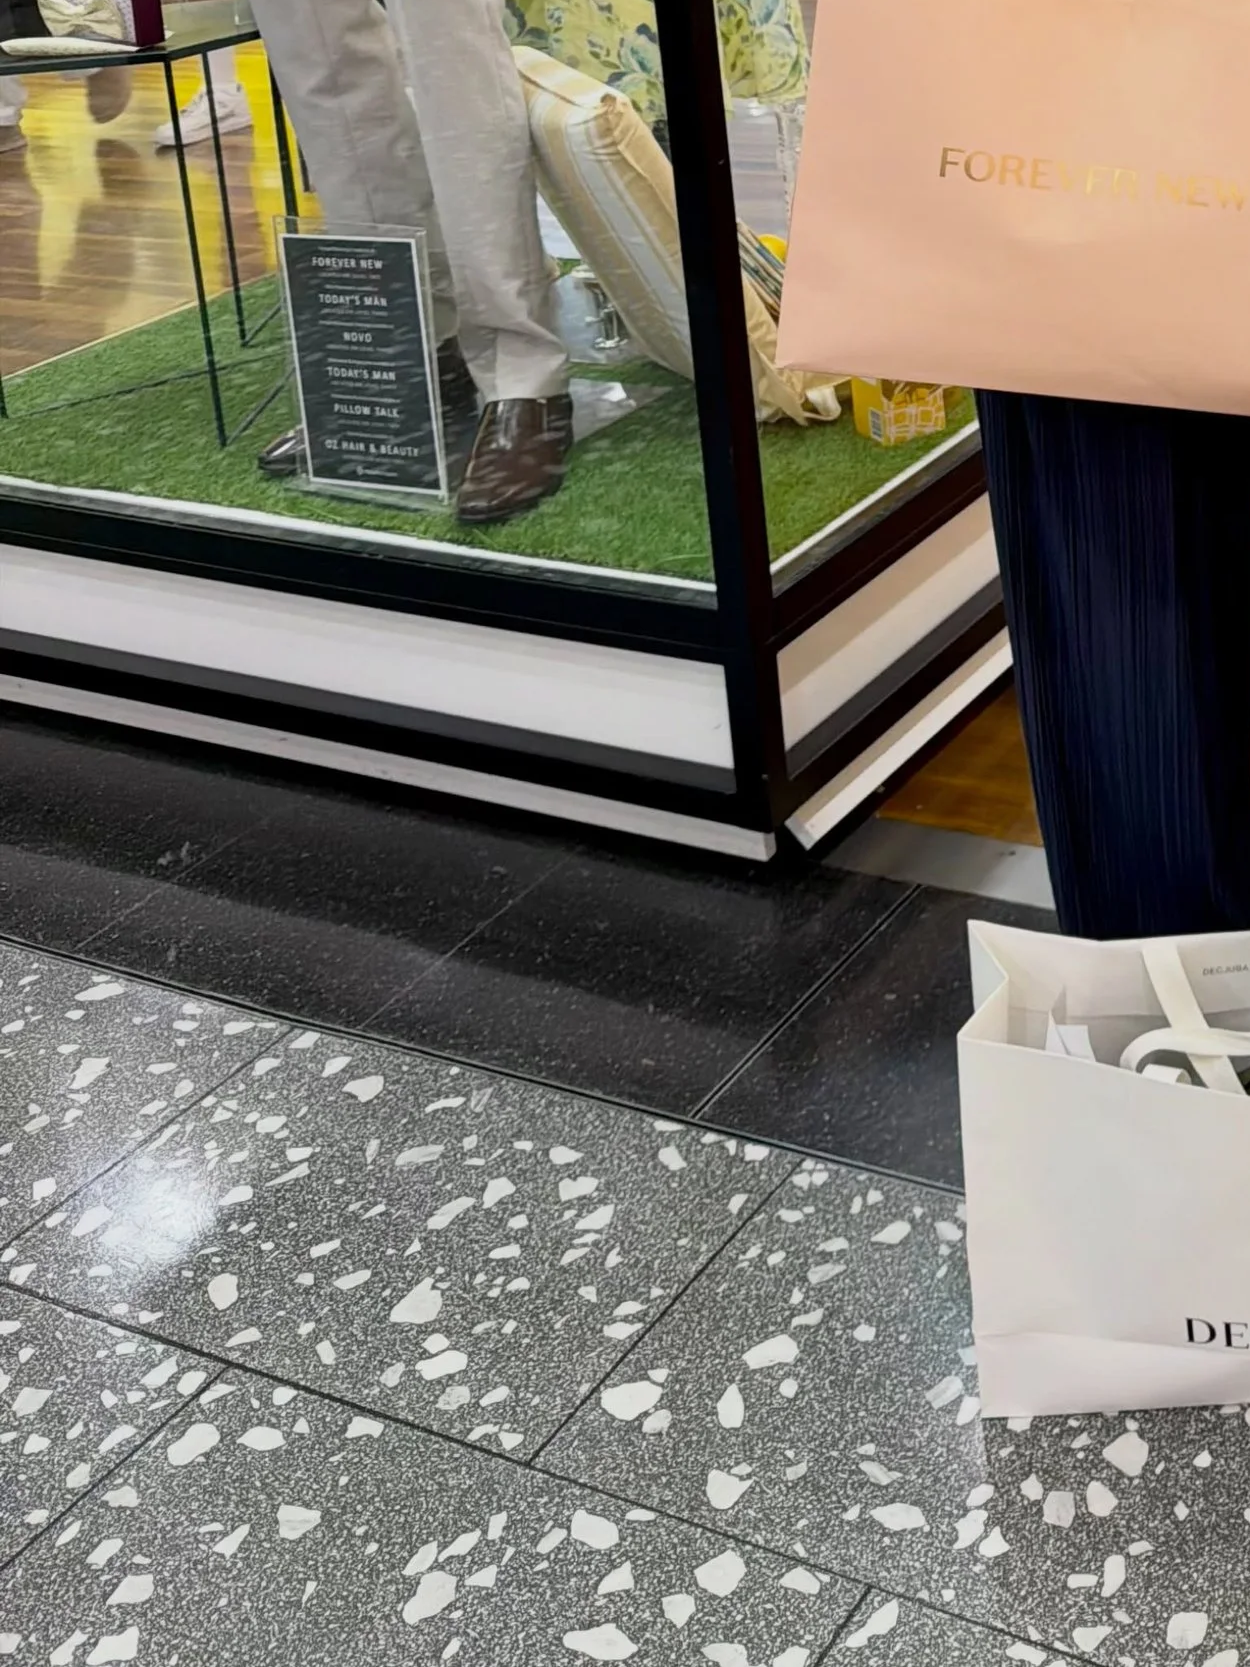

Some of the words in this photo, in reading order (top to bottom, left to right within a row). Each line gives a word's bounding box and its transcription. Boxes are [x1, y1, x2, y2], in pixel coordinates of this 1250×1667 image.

[938, 146, 1140, 203] FOREVER
[1154, 171, 1246, 212] NEW
[312, 257, 356, 268] FOREVER
[359, 259, 384, 269] NEW
[318, 294, 361, 306] TODAY'S
[364, 295, 388, 307] MAN
[327, 366, 369, 377] TODAY'S
[371, 370, 397, 381] MAN
